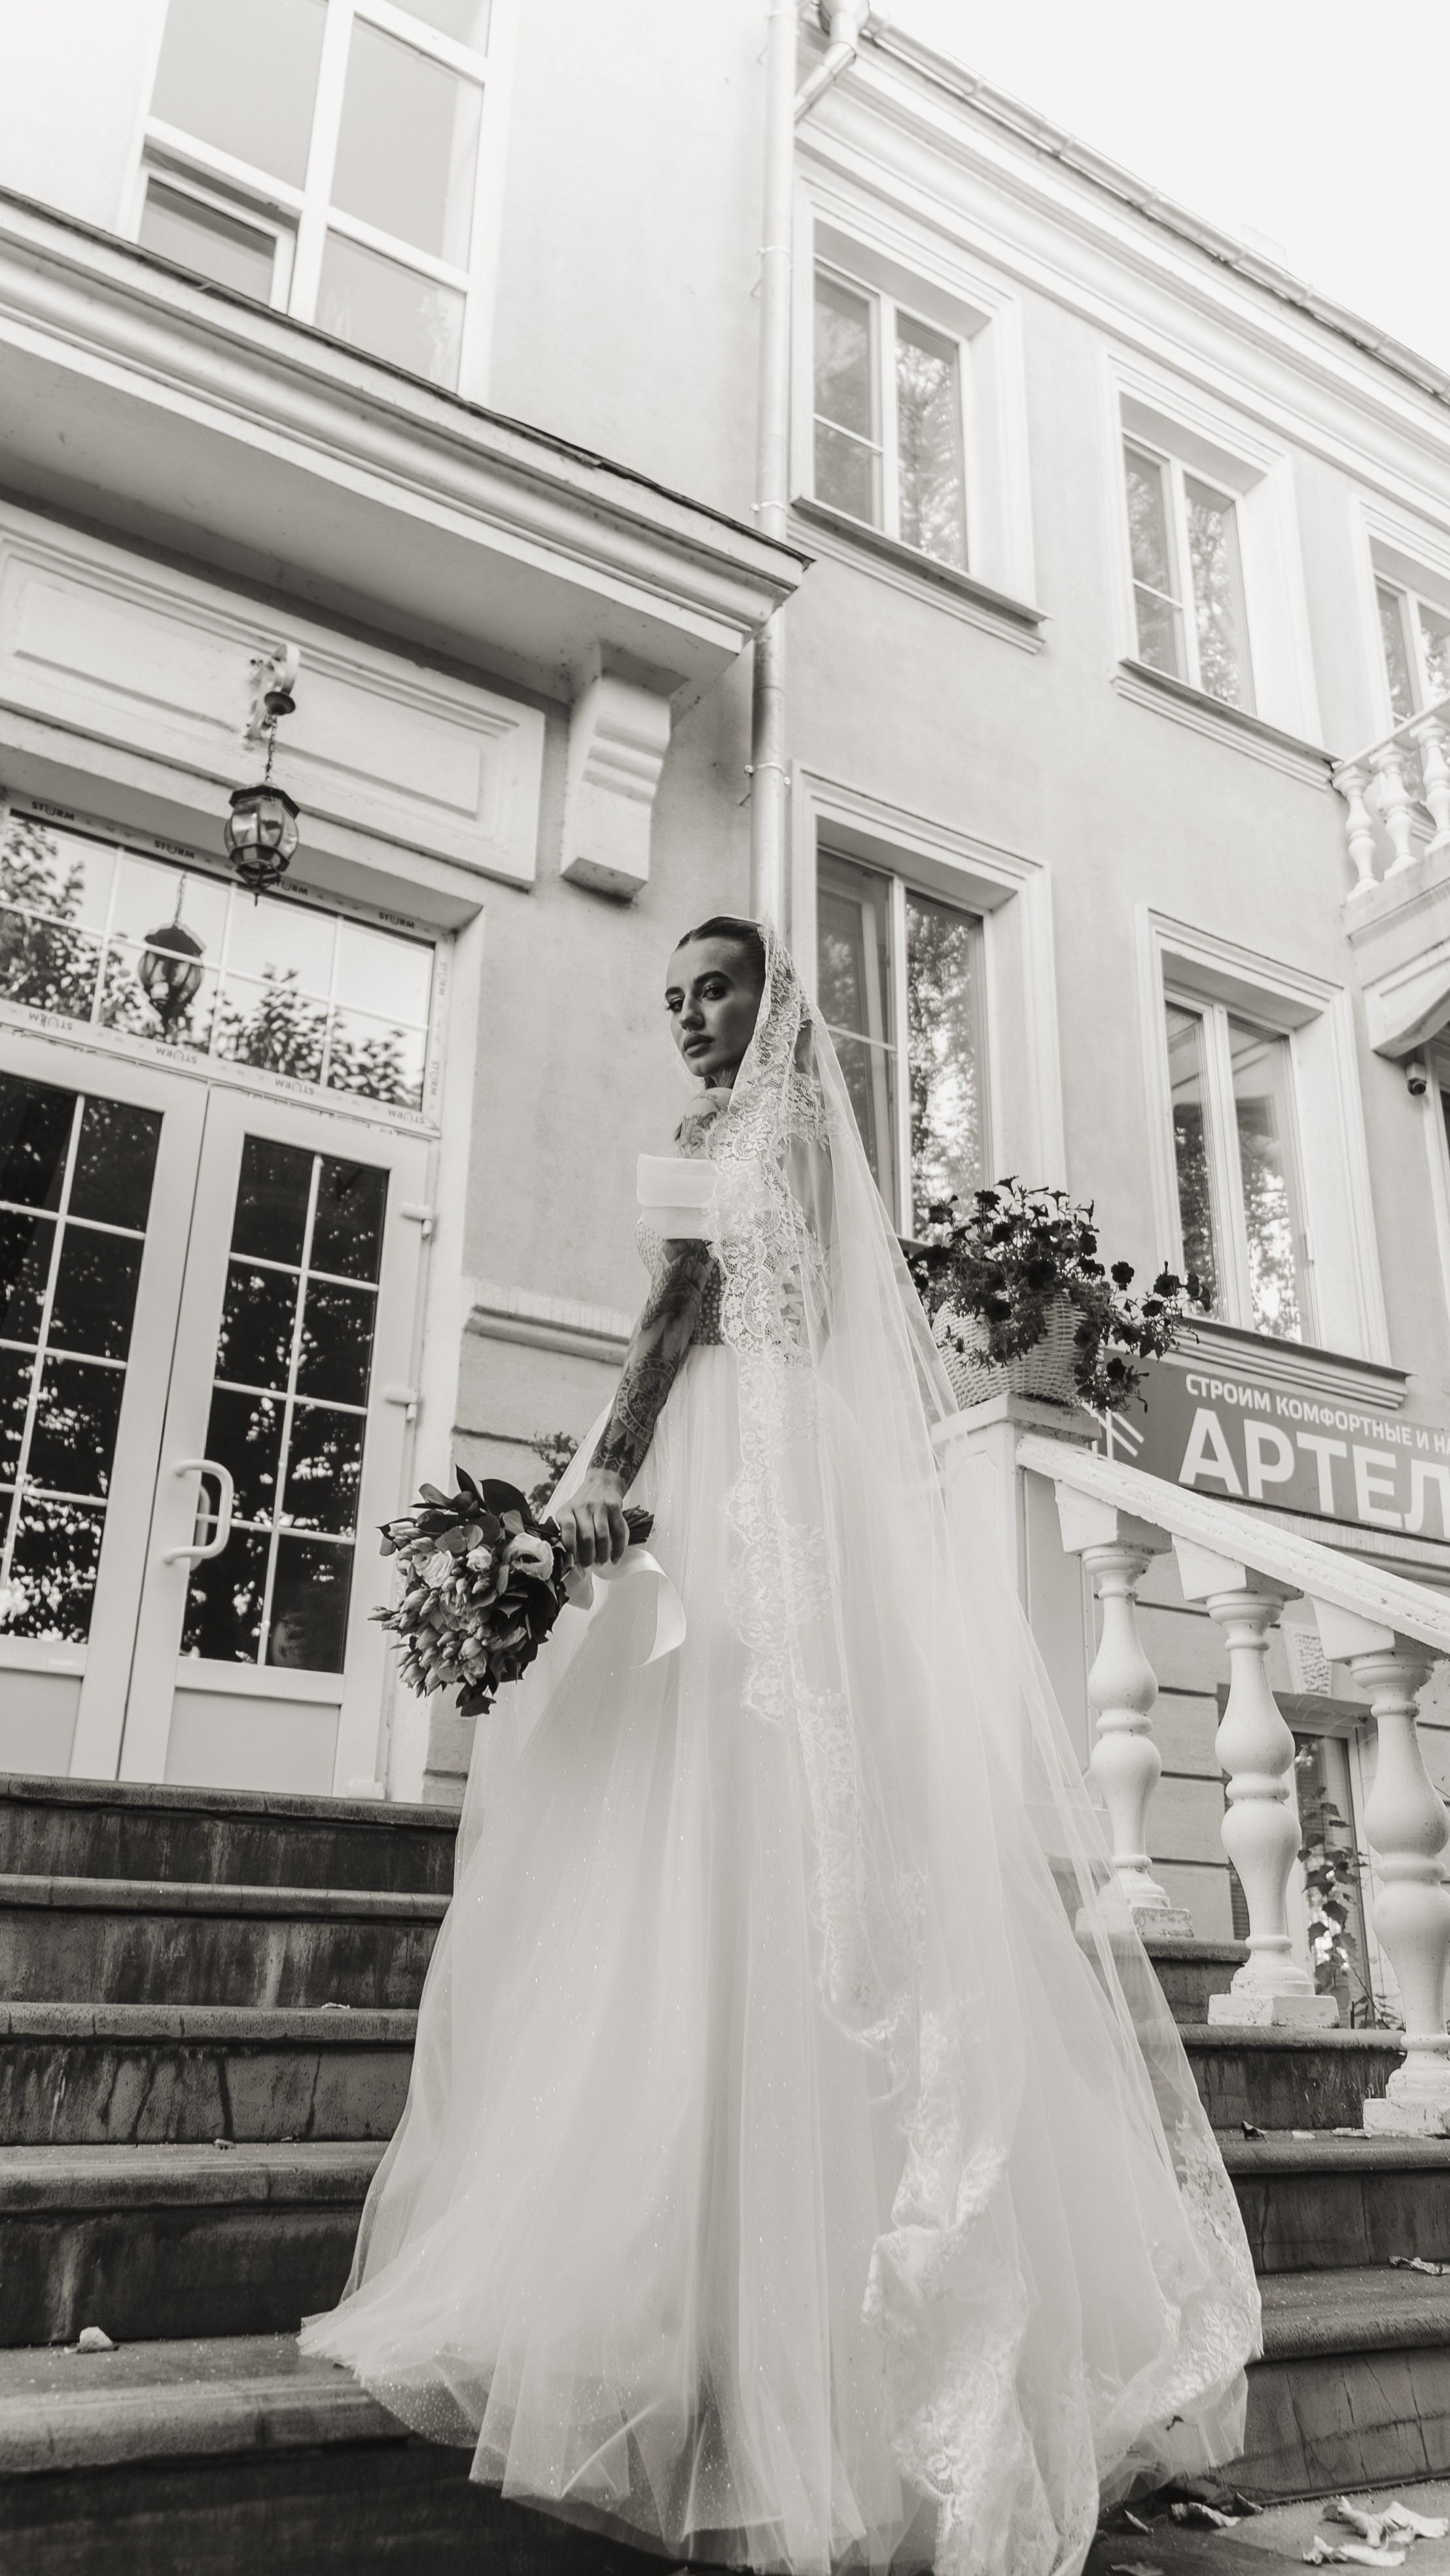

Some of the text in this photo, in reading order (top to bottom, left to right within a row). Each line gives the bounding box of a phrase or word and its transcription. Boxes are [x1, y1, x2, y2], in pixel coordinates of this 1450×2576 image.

[1186, 1374, 1450, 1455] СТРОИМ КОМФОРТНЫЕ И Н
[1178, 1407, 1450, 1540] АРТЕЛ
